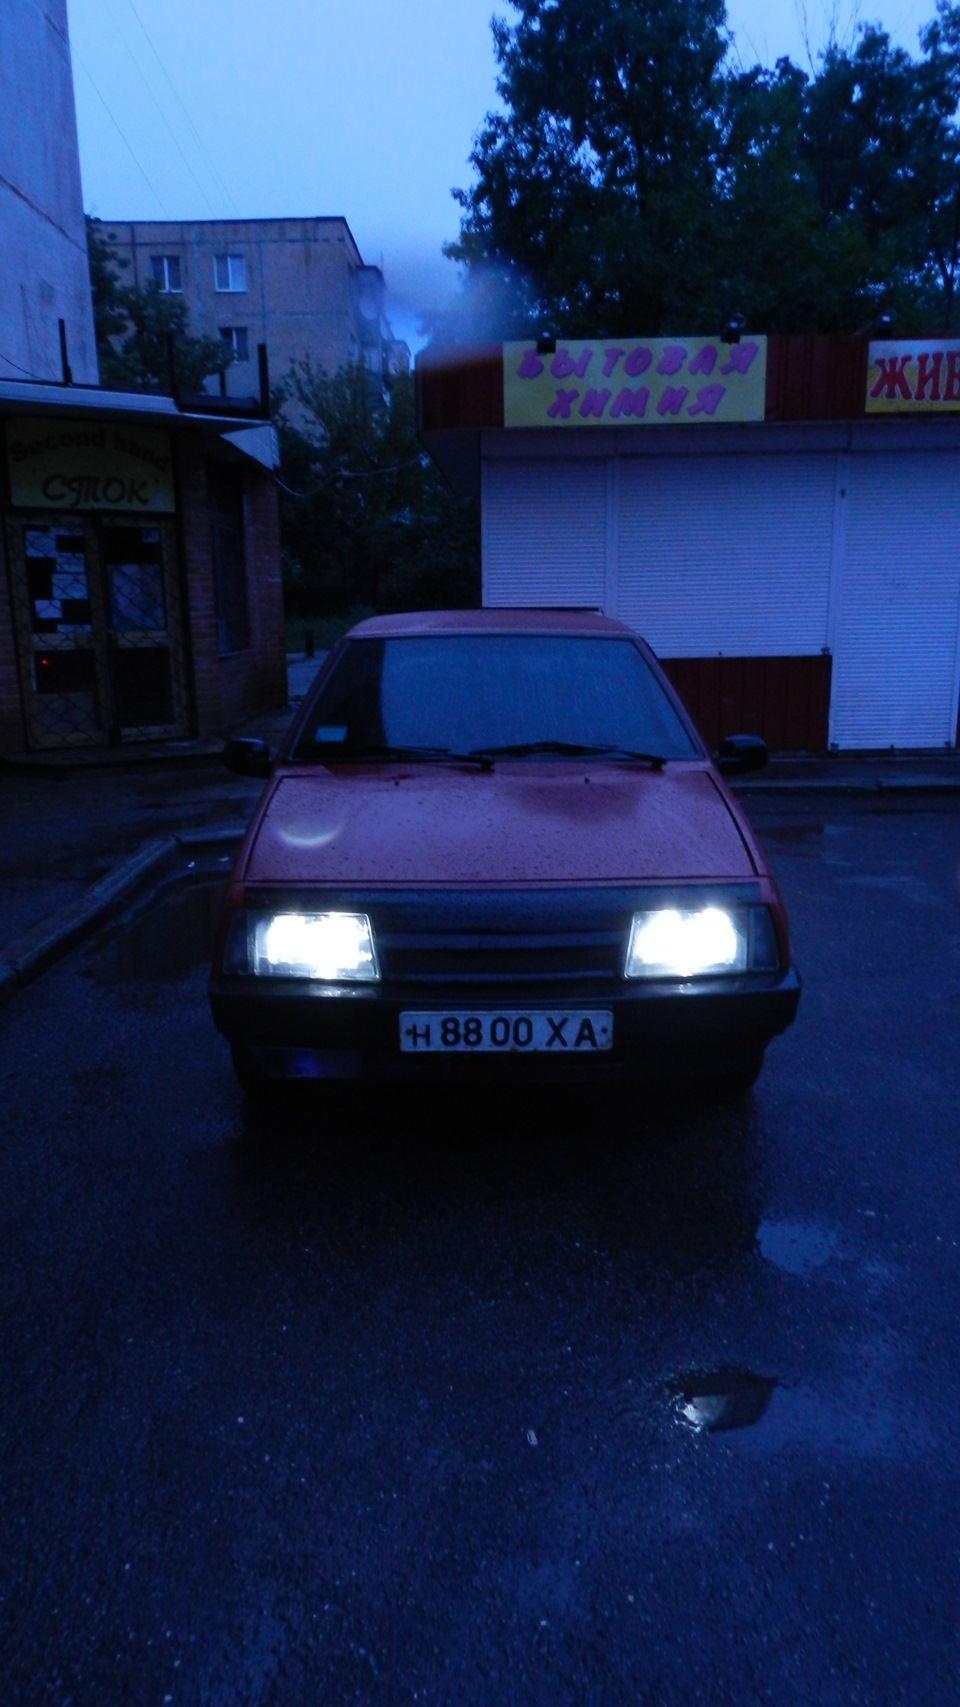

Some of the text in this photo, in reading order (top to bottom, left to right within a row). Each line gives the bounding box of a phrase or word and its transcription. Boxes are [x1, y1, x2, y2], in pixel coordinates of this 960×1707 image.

[518, 343, 759, 379] БЫТОВАЯ
[547, 384, 726, 418] ХИМИЯ
[10, 429, 170, 472] Second hand
